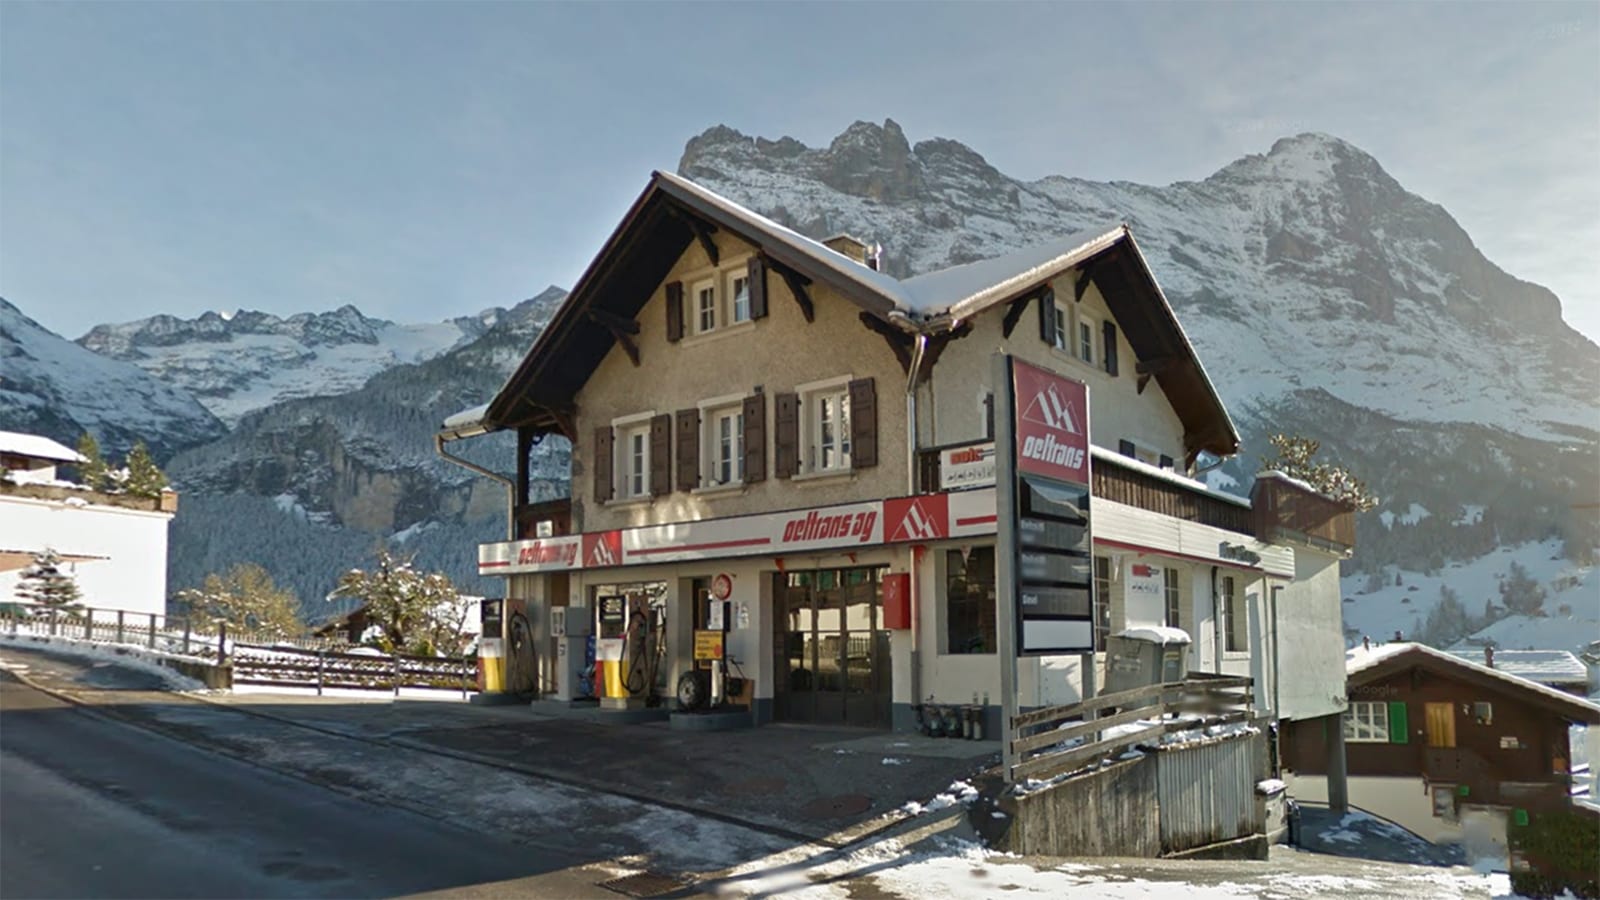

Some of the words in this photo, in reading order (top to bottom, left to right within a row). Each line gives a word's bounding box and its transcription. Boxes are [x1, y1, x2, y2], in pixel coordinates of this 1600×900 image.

[1022, 433, 1084, 470] oeltrans
[782, 511, 853, 542] oeltrans
[852, 511, 878, 542] ag
